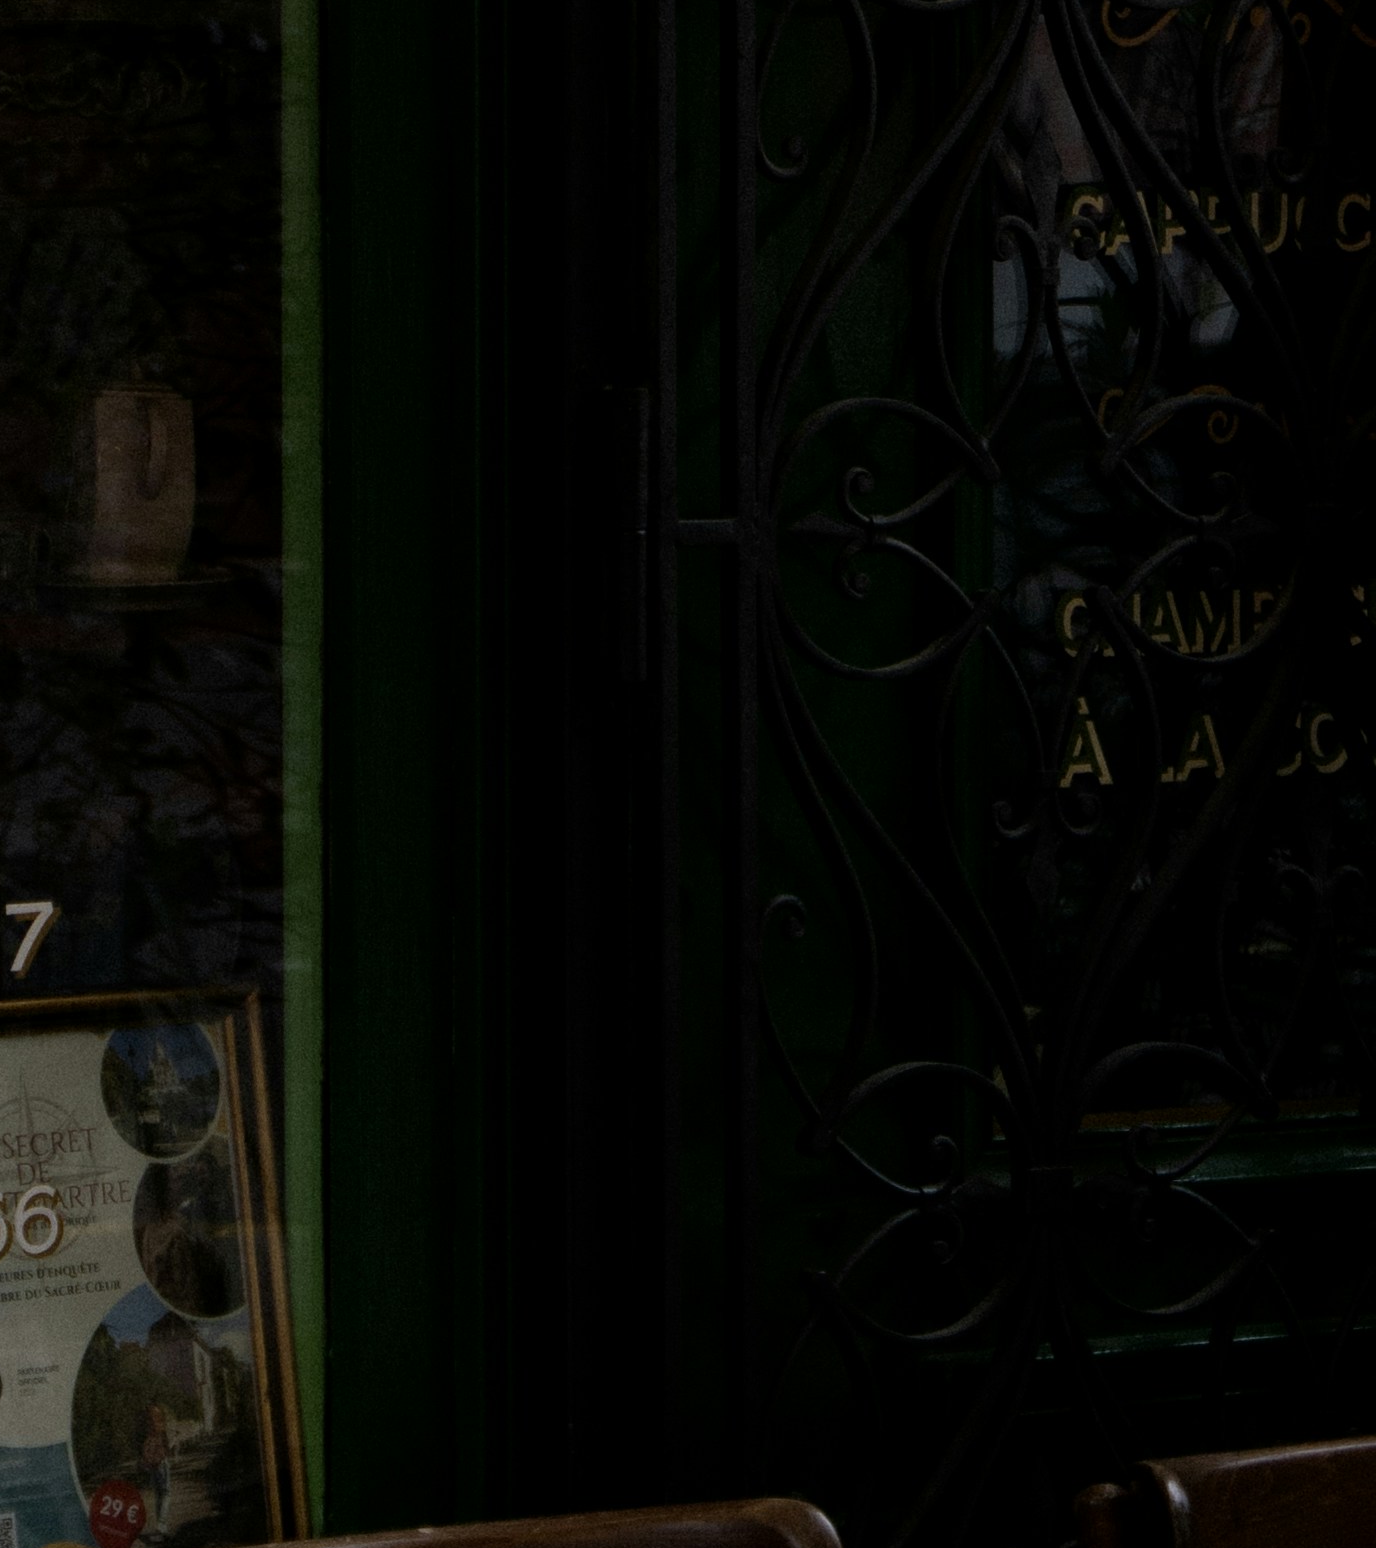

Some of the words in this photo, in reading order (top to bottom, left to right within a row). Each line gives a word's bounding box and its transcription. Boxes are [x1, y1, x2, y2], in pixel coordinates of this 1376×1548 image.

[1056, 694, 1115, 788] À
[2, 1127, 98, 1160] SECRET
[17, 1160, 52, 1187] DE
[100, 1494, 124, 1519] 29
[126, 1504, 140, 1525] €
